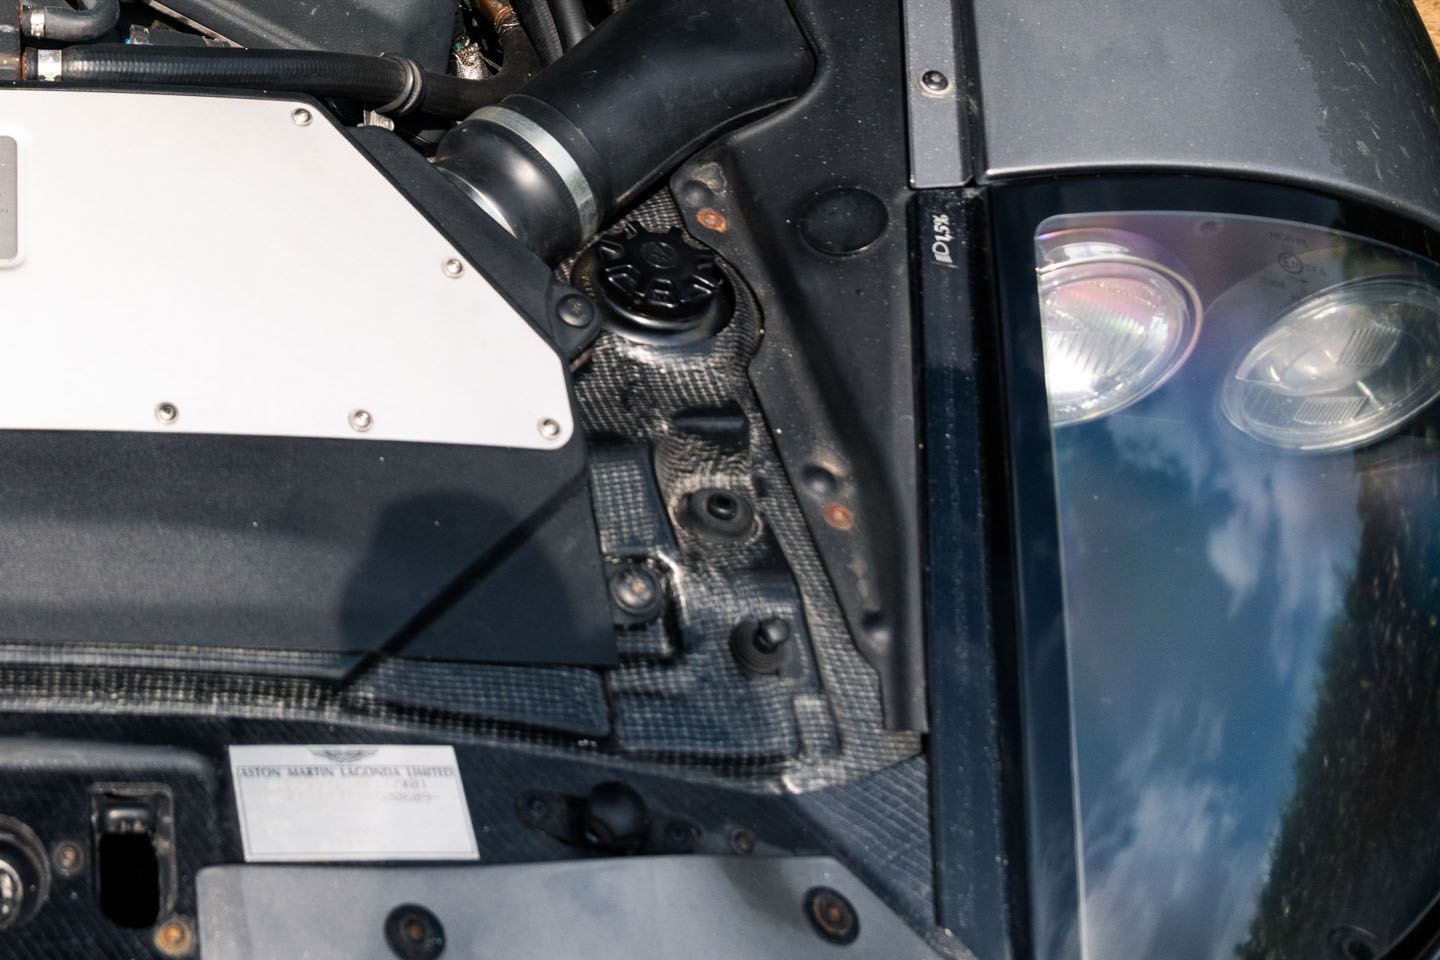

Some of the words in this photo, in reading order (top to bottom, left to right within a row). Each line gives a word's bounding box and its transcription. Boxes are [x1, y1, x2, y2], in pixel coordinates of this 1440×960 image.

[239, 766, 281, 778] ASTON
[287, 766, 334, 778] MARTIN
[340, 766, 401, 778] LAGONDA
[407, 766, 455, 778] LIMITED
